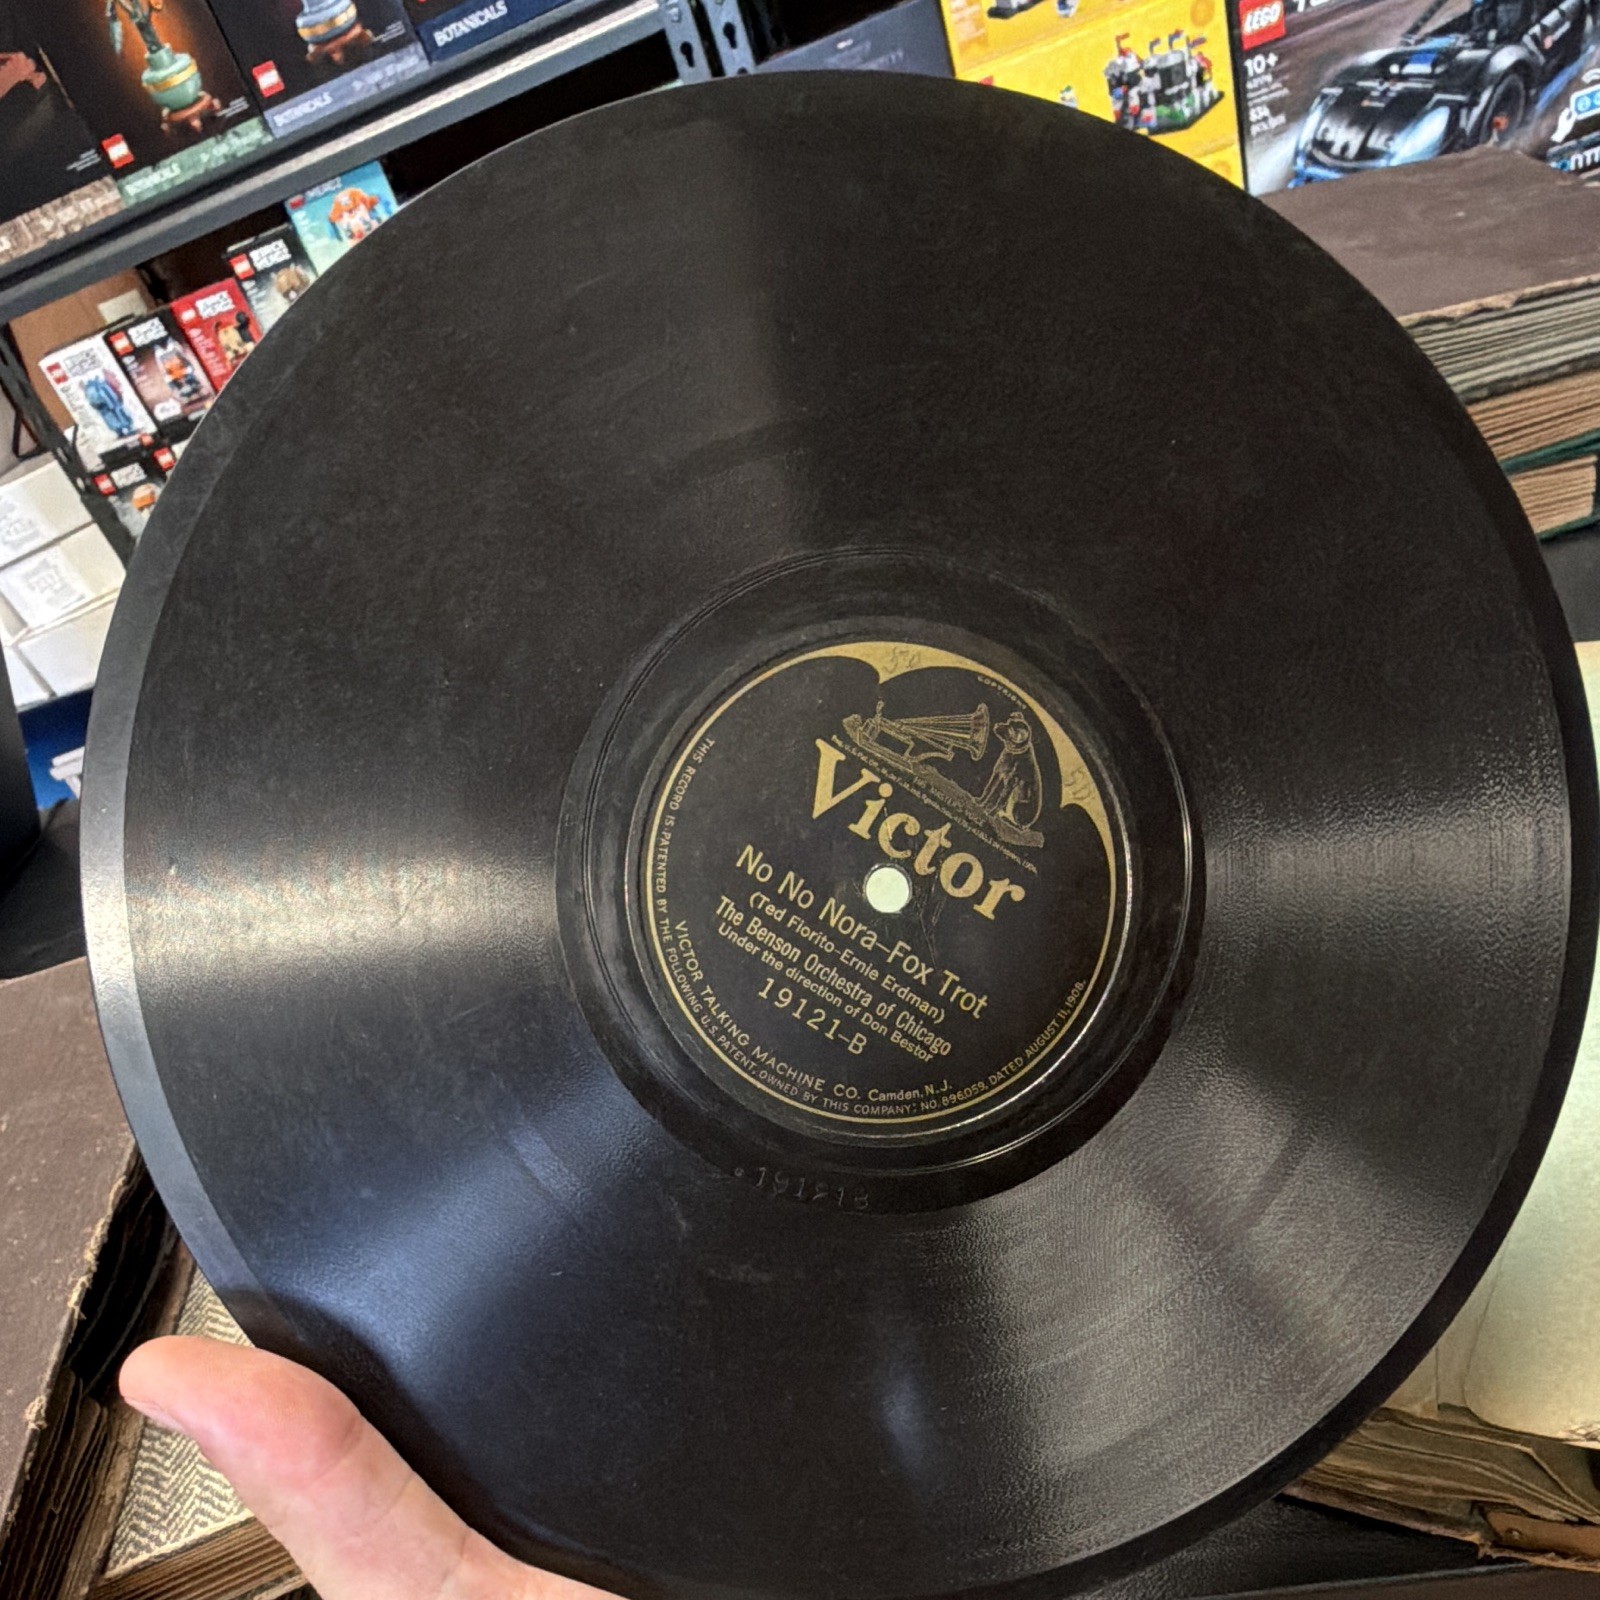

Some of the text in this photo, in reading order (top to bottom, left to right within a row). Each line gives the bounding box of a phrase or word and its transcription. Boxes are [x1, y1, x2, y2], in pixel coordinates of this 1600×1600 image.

[432, 0, 508, 47] BOTANICALS
[1243, 1, 1282, 35] LEGO
[1244, 52, 1279, 76] 10+
[692, 738, 715, 763] THIS
[669, 765, 696, 810] RECORD
[664, 815, 675, 826] IS
[812, 739, 1025, 920] Victor
[656, 831, 671, 893] PATENTED
[656, 898, 667, 913] BY
[659, 917, 673, 943] THE
[735, 844, 773, 882] No
[777, 870, 814, 909] No
[938, 969, 987, 1019] Trot
[715, 895, 951, 1056] The Benson Orchestra of Chicago
[749, 891, 787, 922] (Ted
[880, 974, 945, 1024] Erdman)
[665, 947, 703, 1013] FOLLOWING
[718, 921, 936, 1062] Under the direction of Don Bestor
[674, 920, 703, 982] VICTOR
[700, 984, 750, 1046] TALKING
[751, 1045, 825, 1091] MACHINE
[833, 1083, 861, 1099] CO.
[1024, 1018, 1059, 1058] AUGUST
[758, 1070, 798, 1095] OWNED
[988, 1056, 1023, 1085] DATED
[802, 1090, 818, 1103] BY
[823, 1097, 849, 1112] THIS
